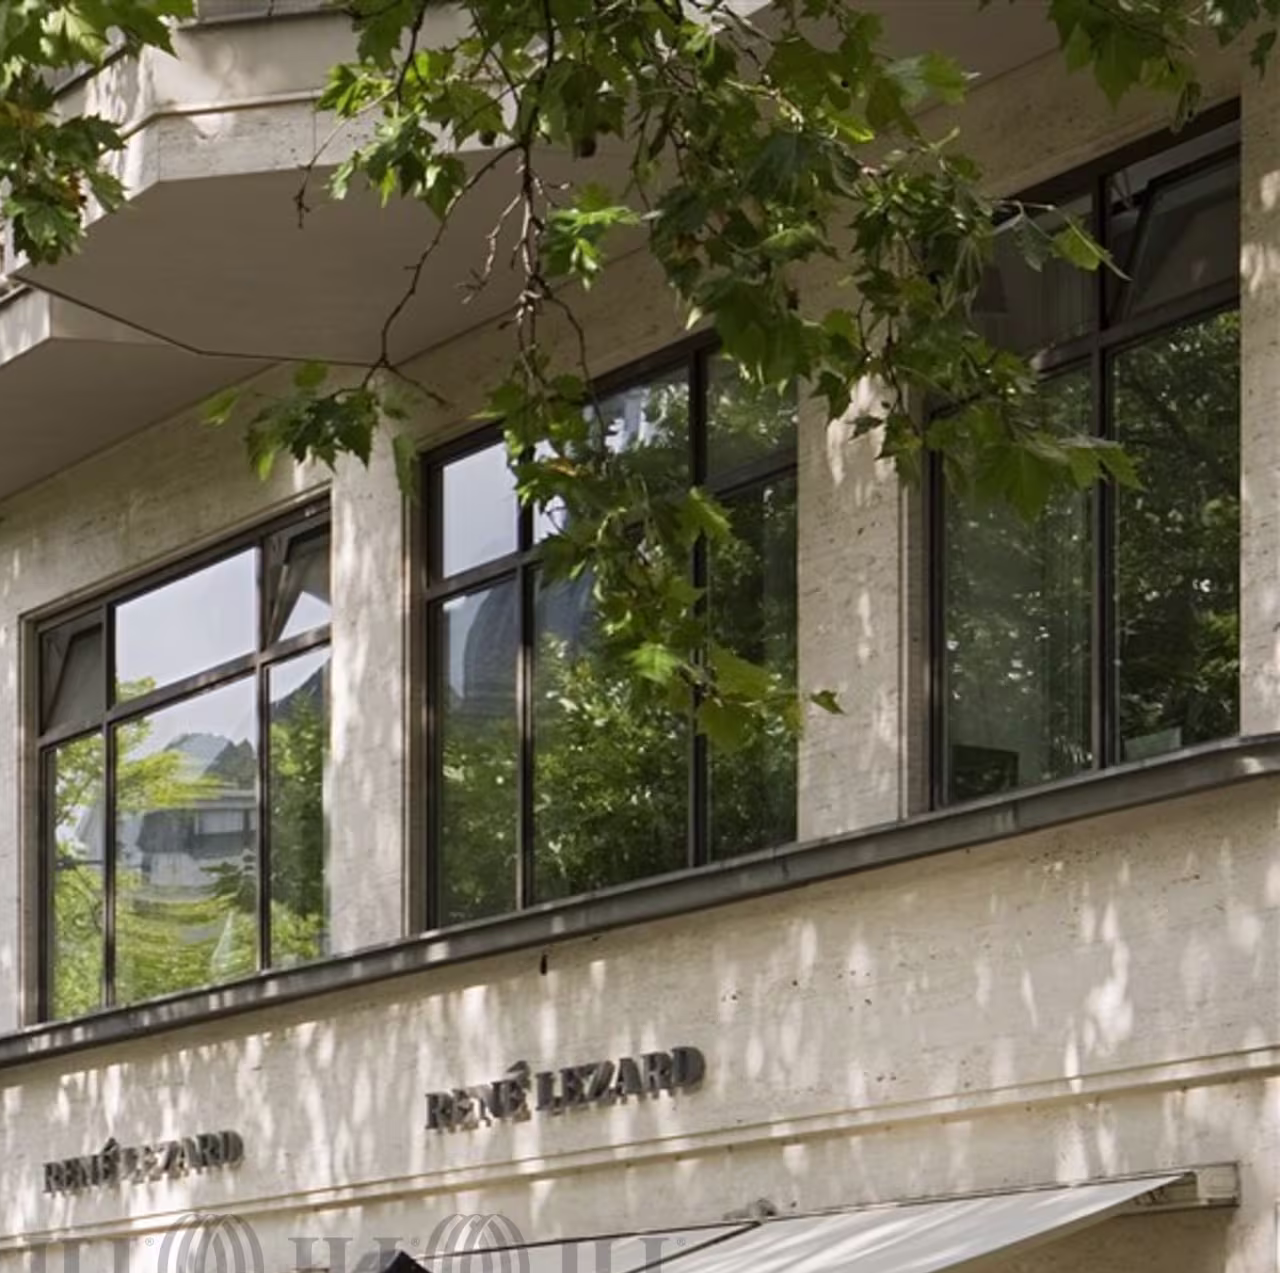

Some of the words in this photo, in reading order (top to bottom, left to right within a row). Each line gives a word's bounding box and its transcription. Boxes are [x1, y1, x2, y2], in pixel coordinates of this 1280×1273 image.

[424, 1060, 532, 1131] RENÉ
[535, 1046, 707, 1114] LEZARD
[43, 1138, 120, 1194] RENÉ
